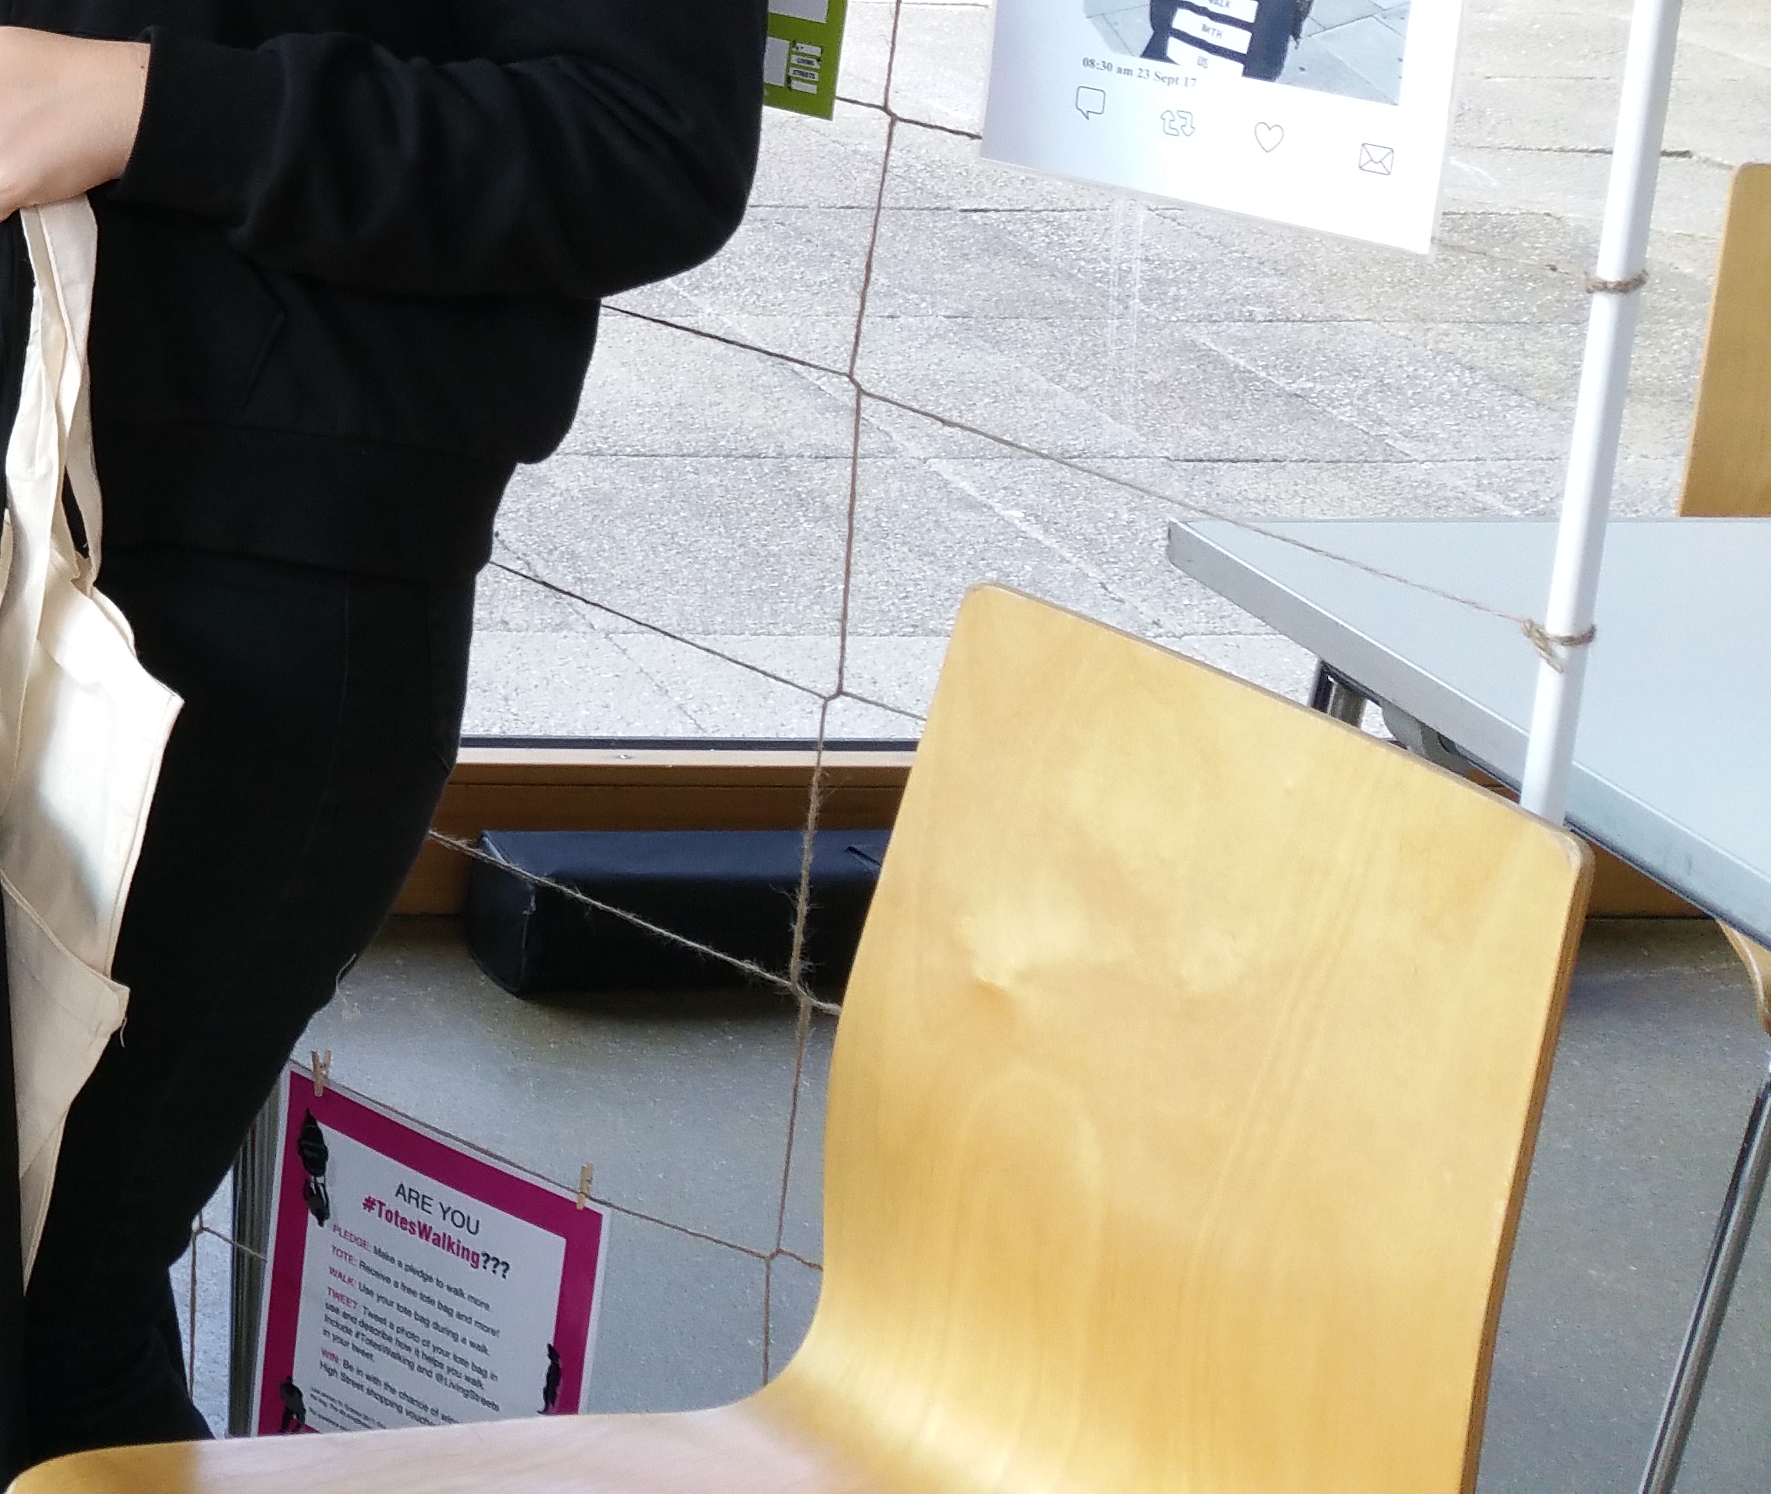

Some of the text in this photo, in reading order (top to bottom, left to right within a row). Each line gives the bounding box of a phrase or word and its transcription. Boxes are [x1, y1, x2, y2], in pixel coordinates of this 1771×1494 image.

[1082, 57, 1197, 88] 08:30 am 23 Sept 17
[394, 1183, 480, 1235] ARE YOU
[362, 1195, 510, 1279] #TotesWalking???
